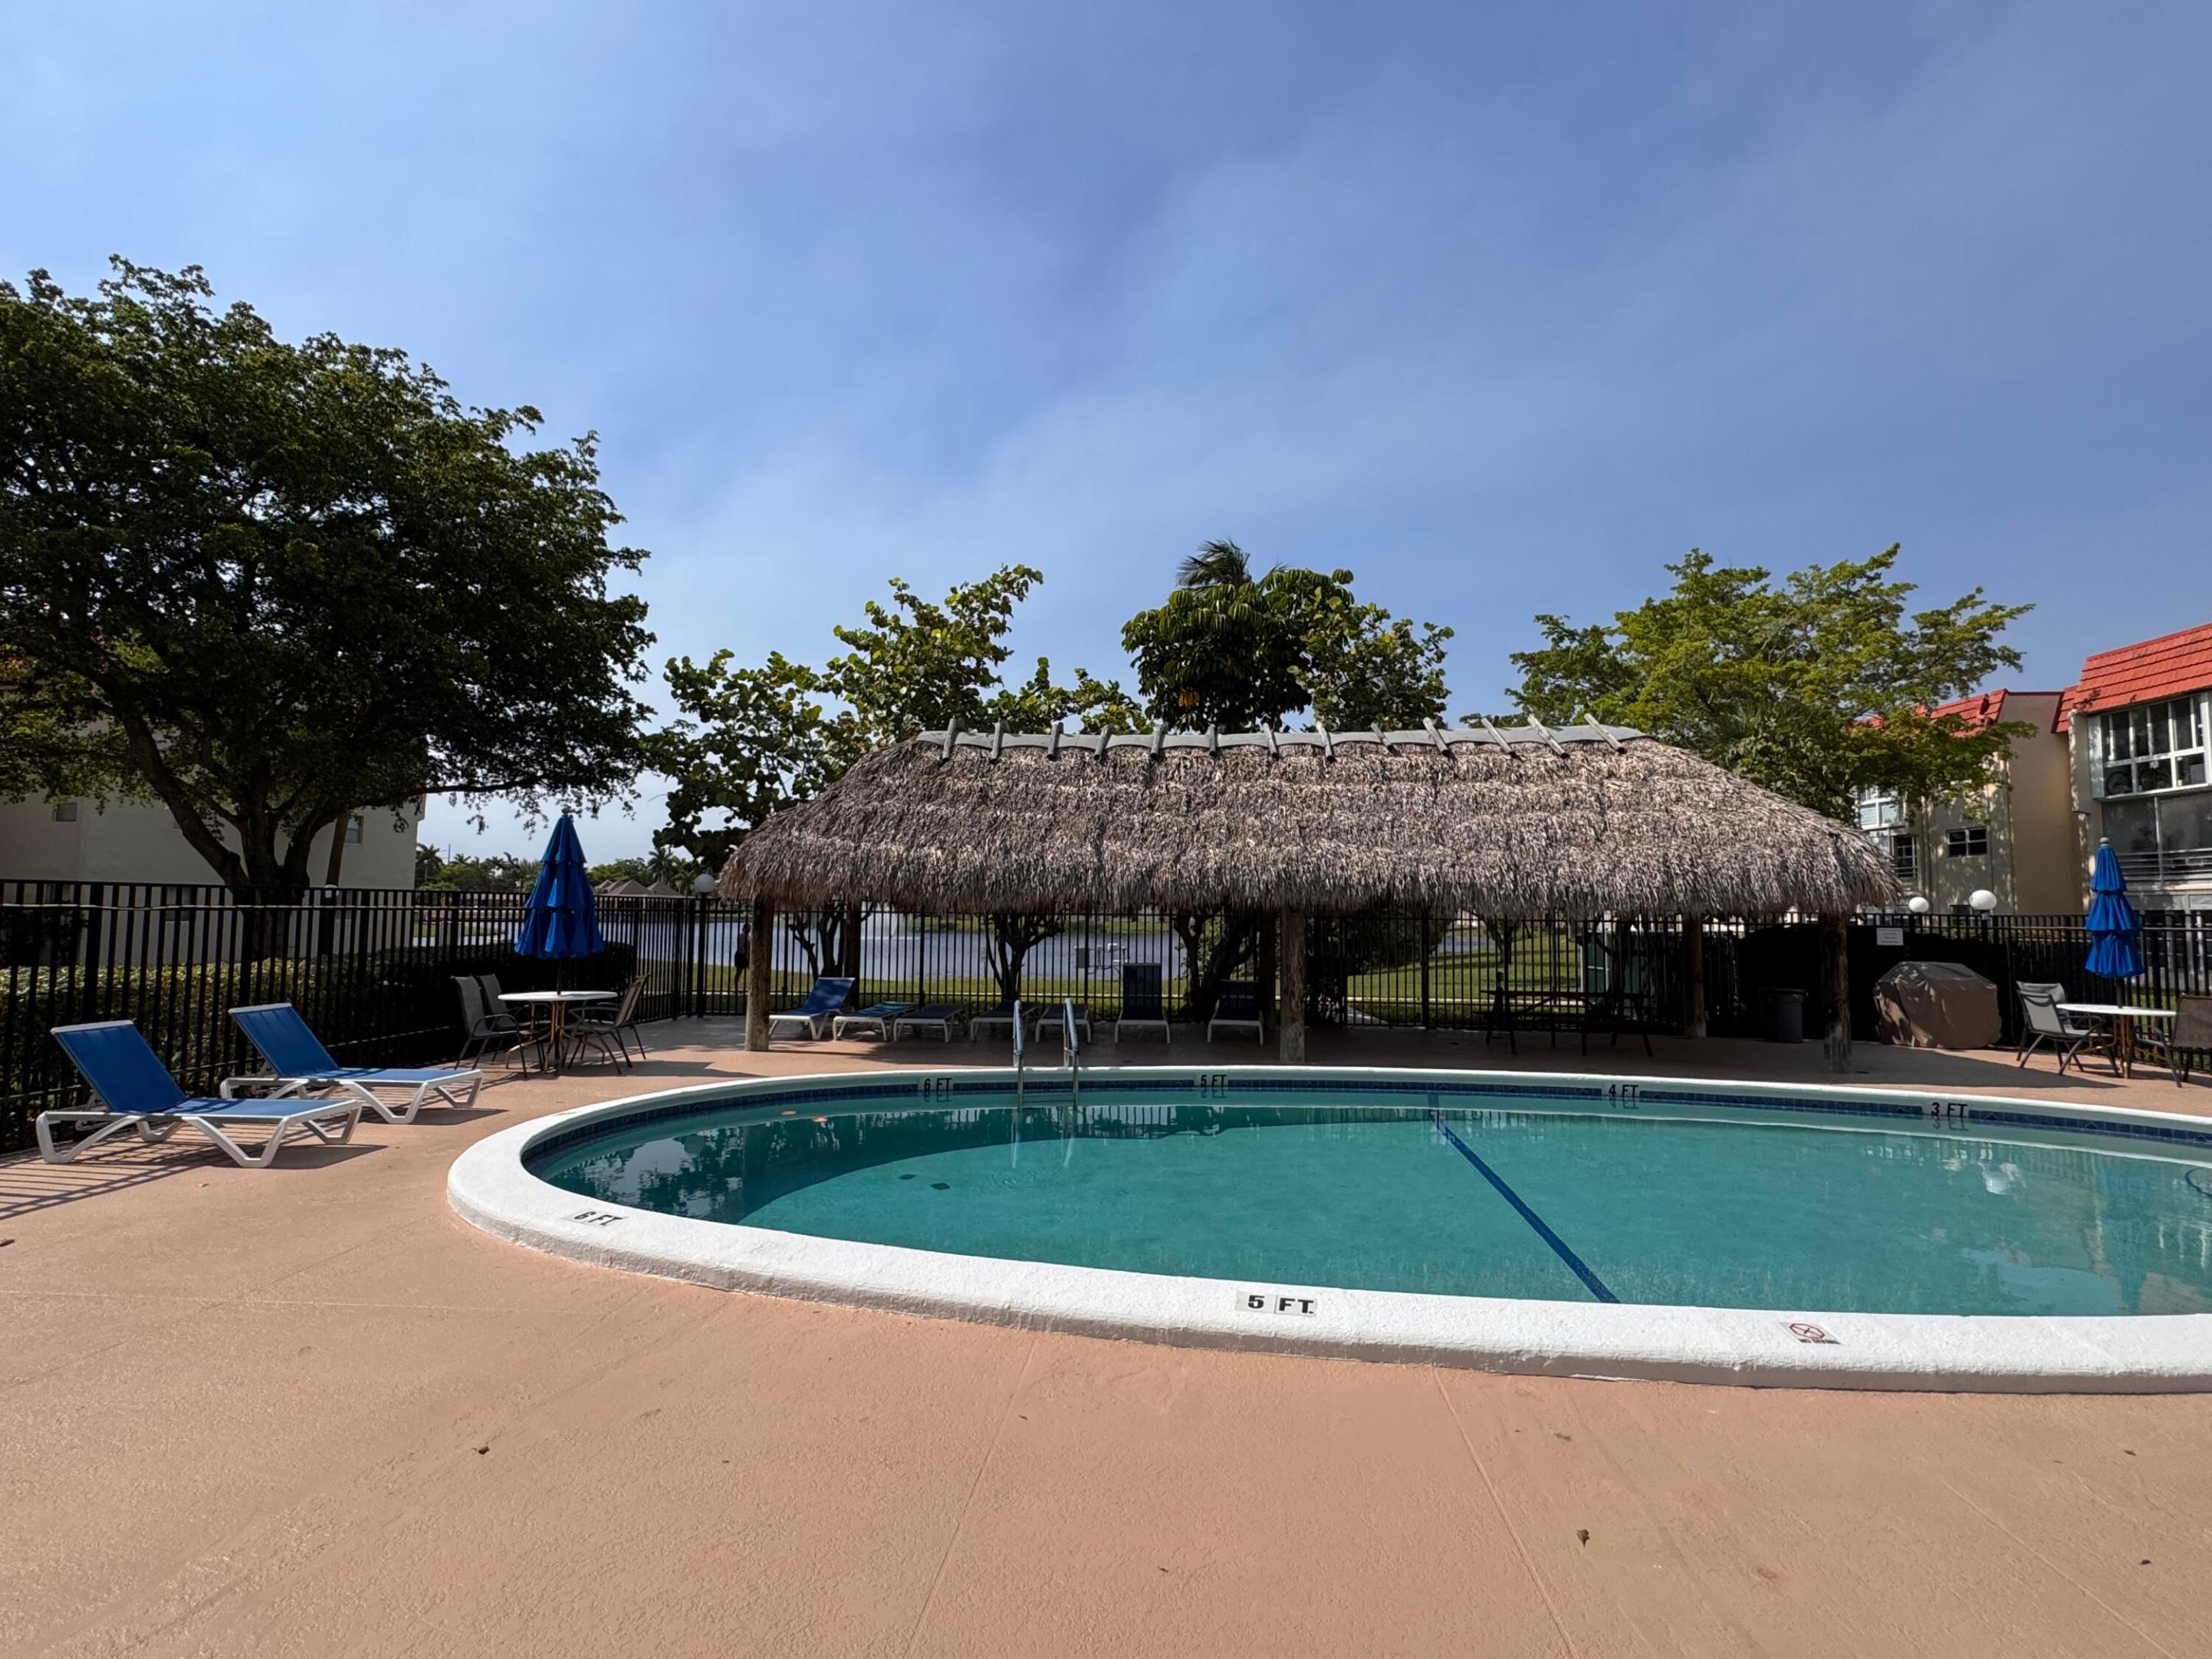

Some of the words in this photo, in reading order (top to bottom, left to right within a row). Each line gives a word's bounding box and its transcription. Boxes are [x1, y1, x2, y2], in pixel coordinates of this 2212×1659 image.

[924, 1078, 931, 1091] 6
[937, 1078, 952, 1091] FT
[1200, 1075, 1207, 1088] 5
[1212, 1075, 1227, 1088] FT
[1609, 1084, 1616, 1097] 4
[1621, 1084, 1639, 1098] FT
[1931, 1102, 1940, 1116] 3
[1947, 1103, 1968, 1117] FT
[574, 1211, 597, 1220] 6
[1247, 1295, 1265, 1309] 5
